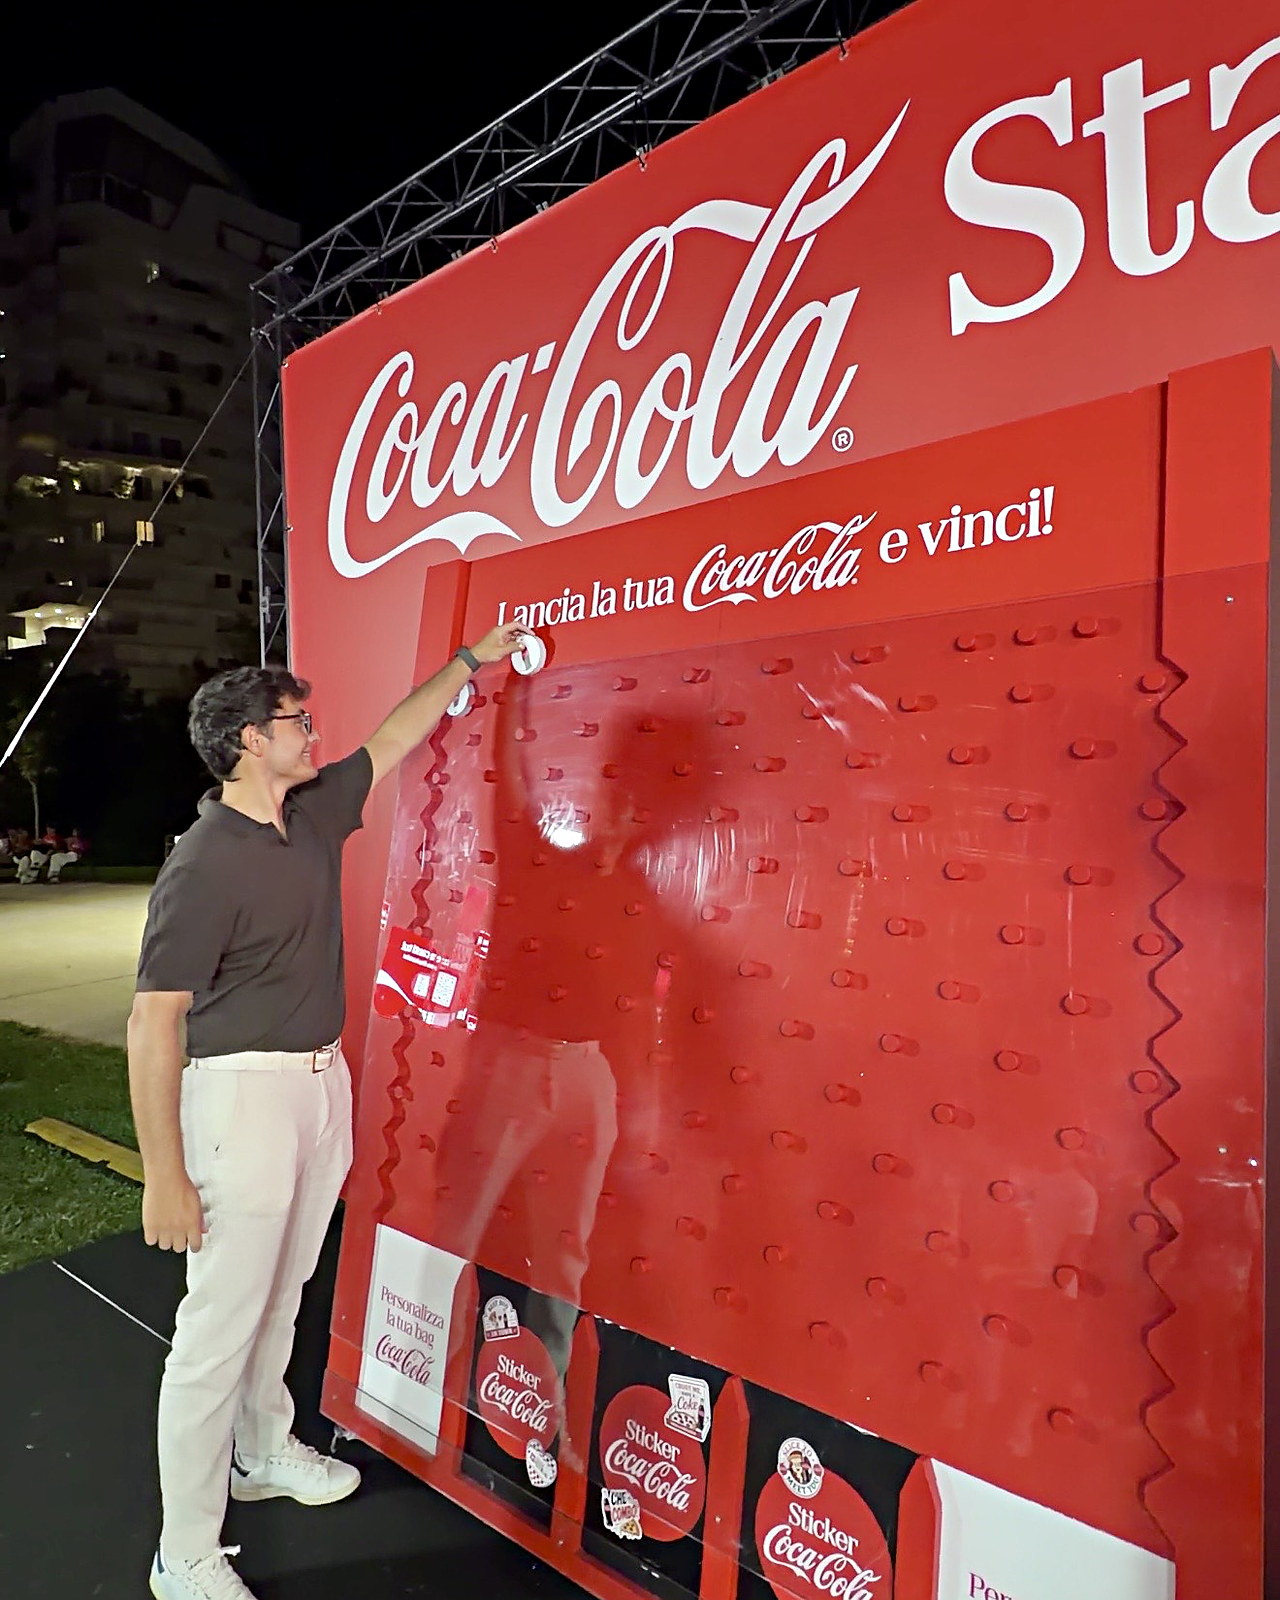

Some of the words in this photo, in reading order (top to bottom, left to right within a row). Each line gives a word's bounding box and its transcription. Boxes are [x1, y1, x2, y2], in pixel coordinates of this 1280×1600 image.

[497, 587, 585, 629] Lancia
[590, 581, 617, 619] la
[623, 575, 675, 612] tua
[682, 511, 878, 612] Coca-Cola
[879, 528, 910, 564] e
[918, 486, 1055, 556] vinci!
[381, 1286, 444, 1330] Personalizza
[386, 1308, 395, 1327] la
[396, 1315, 413, 1336] tua
[414, 1322, 435, 1350] bag
[375, 1334, 435, 1386] Coca-Cola
[497, 1354, 541, 1390] Sticker
[480, 1372, 554, 1433] Coca-Cola
[677, 1396, 699, 1411] Coke
[625, 1419, 680, 1463] Sticker
[604, 1438, 697, 1512] Coca-Cola
[788, 1502, 859, 1556] Sticker
